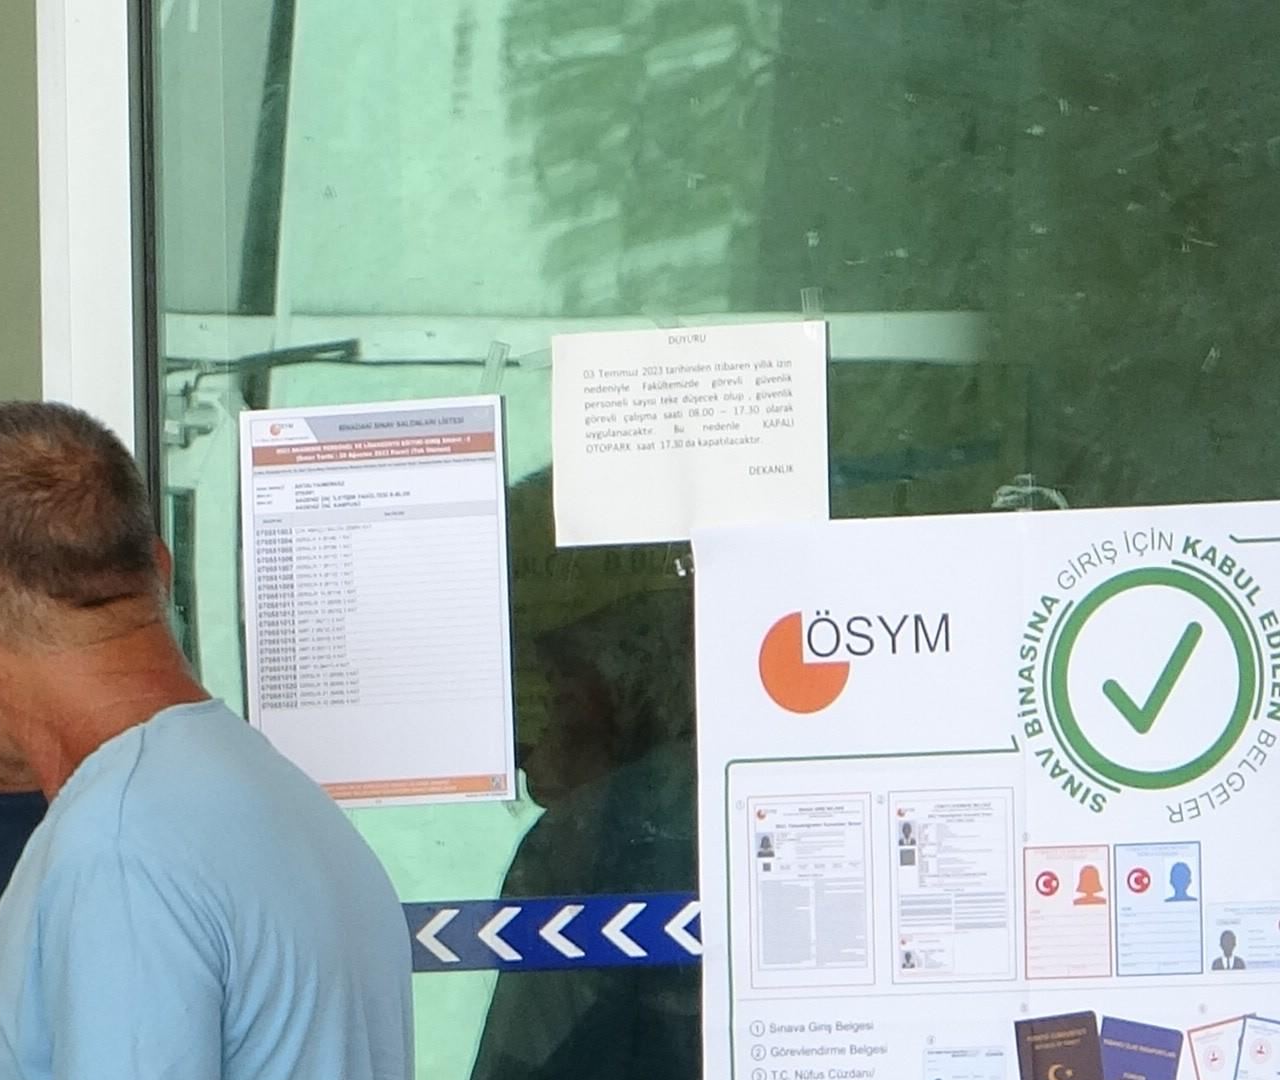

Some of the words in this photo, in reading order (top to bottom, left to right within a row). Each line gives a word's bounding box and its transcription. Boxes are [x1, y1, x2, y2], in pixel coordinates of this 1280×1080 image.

[668, 334, 706, 344] DUYURU
[599, 369, 638, 378] Temmuz
[643, 366, 663, 376] 2023
[666, 364, 711, 374] tarihinden
[715, 362, 750, 371] itibaren
[777, 360, 792, 368] izin
[584, 384, 629, 394] nedeniyle
[643, 379, 699, 391] Fakültemizde
[712, 376, 742, 389] görevli
[755, 374, 792, 386] güvenlik
[585, 398, 628, 411] personeli
[633, 399, 656, 407] sayısı
[661, 396, 678, 404] teke
[682, 393, 718, 404] düşecek
[723, 392, 744, 402] olup
[756, 389, 792, 401] güvenlik
[585, 414, 616, 426] görevli
[624, 412, 657, 423] çalışma
[664, 411, 683, 419] saati
[766, 404, 793, 413] olarak
[674, 424, 684, 433] Bu
[703, 422, 740, 431] nedenle
[763, 418, 794, 428] KAPALI
[586, 443, 630, 453] OTOPARK
[637, 442, 655, 450] saat
[749, 464, 793, 475] DEKANLIK
[1124, 527, 1173, 556] İÇİN
[1057, 539, 1118, 590] GİRİŞ
[1182, 536, 1264, 606] KABUL
[807, 610, 949, 657] ÖSYM
[1017, 594, 1060, 739] BİNASINA
[1035, 748, 1107, 814] SINAV
[1167, 729, 1276, 824] BELGELER
[770, 1023, 805, 1033] Sınava
[808, 1022, 832, 1034] Giriş
[836, 1021, 874, 1033] Belgesi
[770, 1046, 846, 1057] Görevlendirme
[849, 1044, 887, 1056] Belgesi
[795, 1070, 824, 1080] Nüfus
